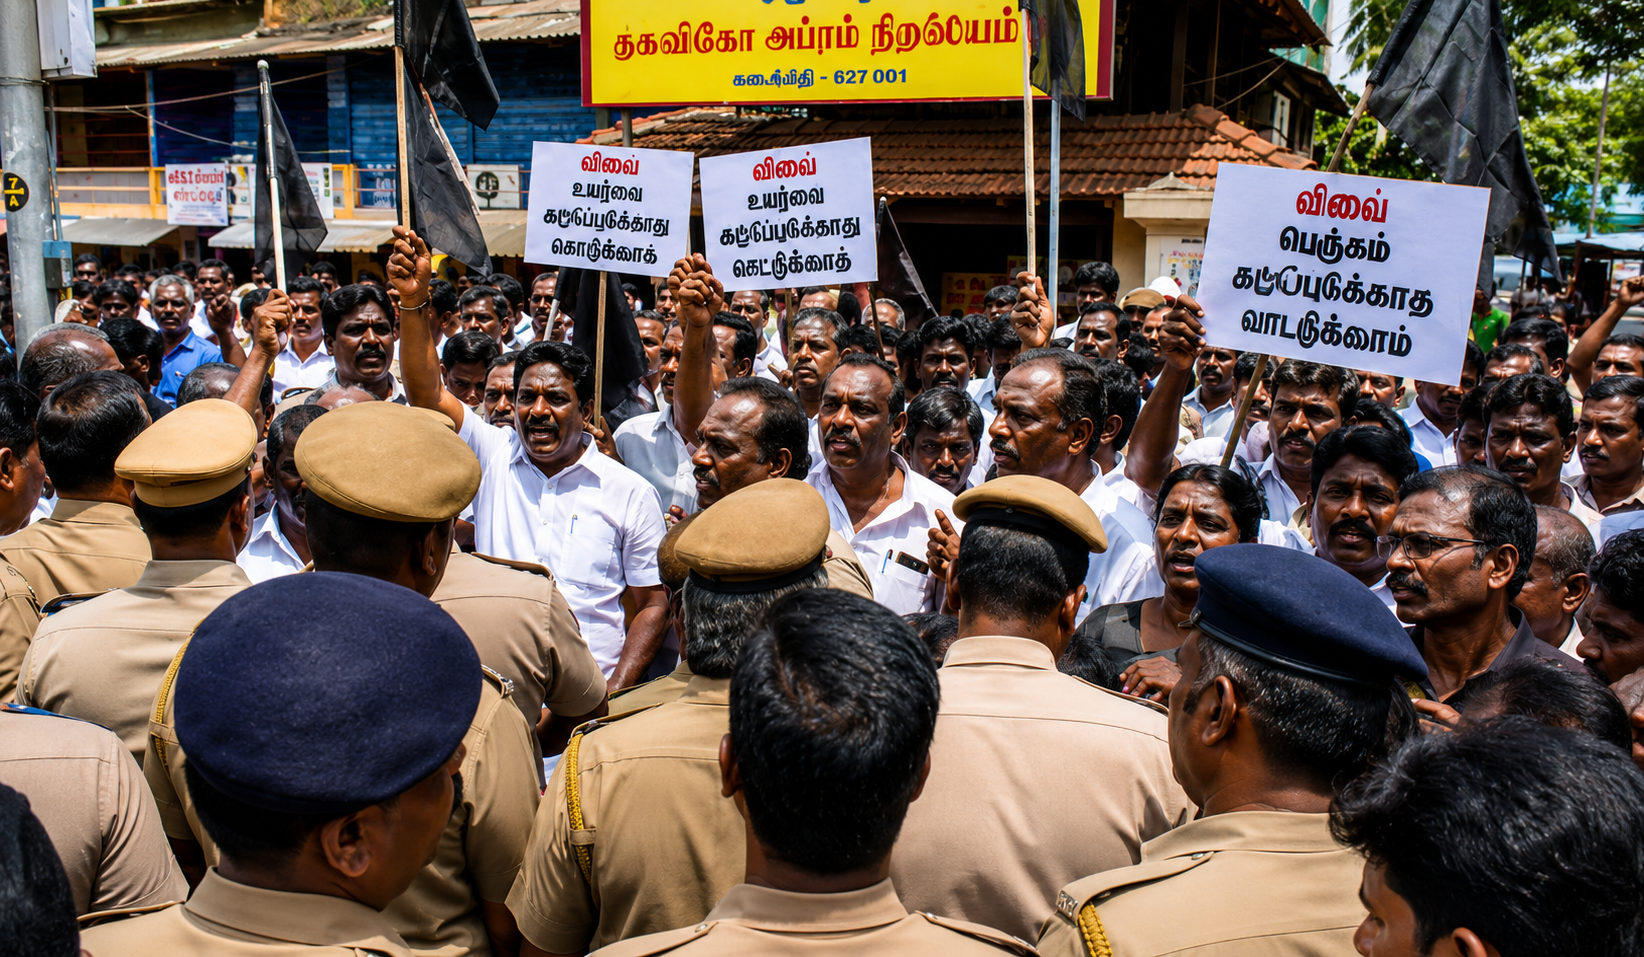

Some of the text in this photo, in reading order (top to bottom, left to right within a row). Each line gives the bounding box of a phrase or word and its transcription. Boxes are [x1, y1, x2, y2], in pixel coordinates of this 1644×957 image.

[833, 69, 868, 85] 627
[872, 68, 906, 84] 001
[8, 177, 19, 190] 7
[9, 194, 20, 207] A
